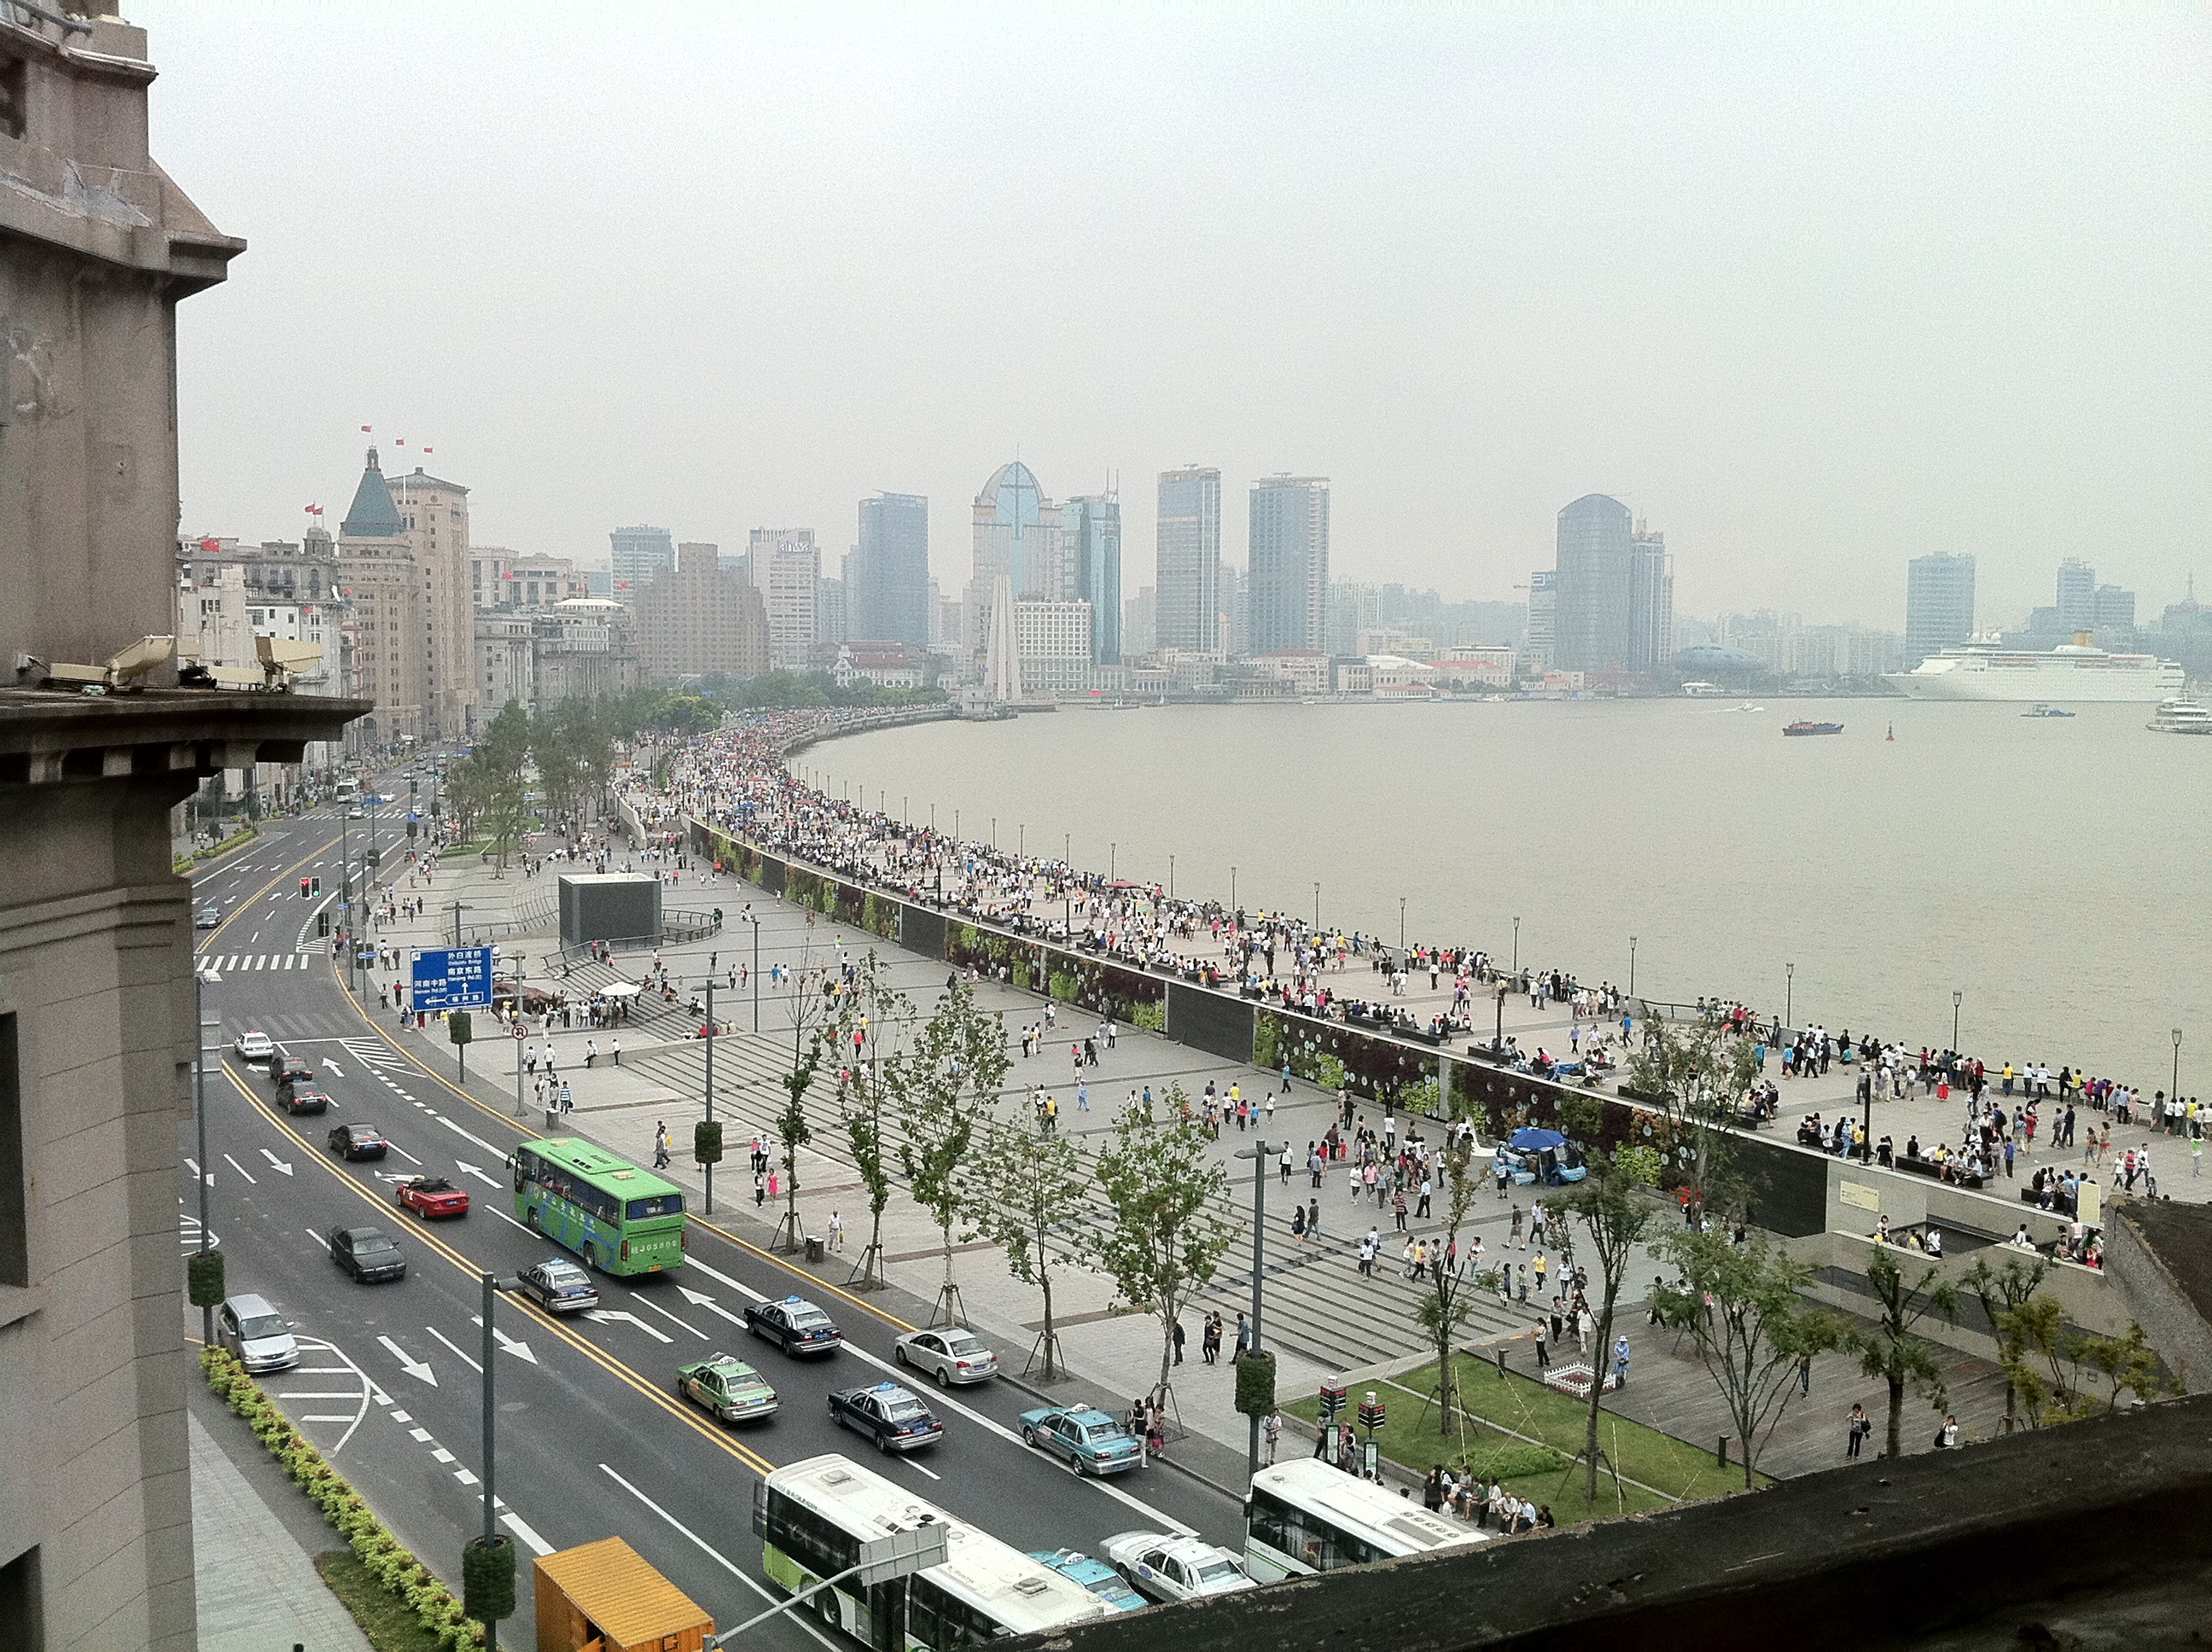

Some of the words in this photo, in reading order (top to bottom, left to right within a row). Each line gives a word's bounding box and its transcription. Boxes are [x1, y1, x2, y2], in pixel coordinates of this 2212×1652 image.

[447, 966, 481, 976] 南京东路
[414, 979, 446, 987] 河南中路
